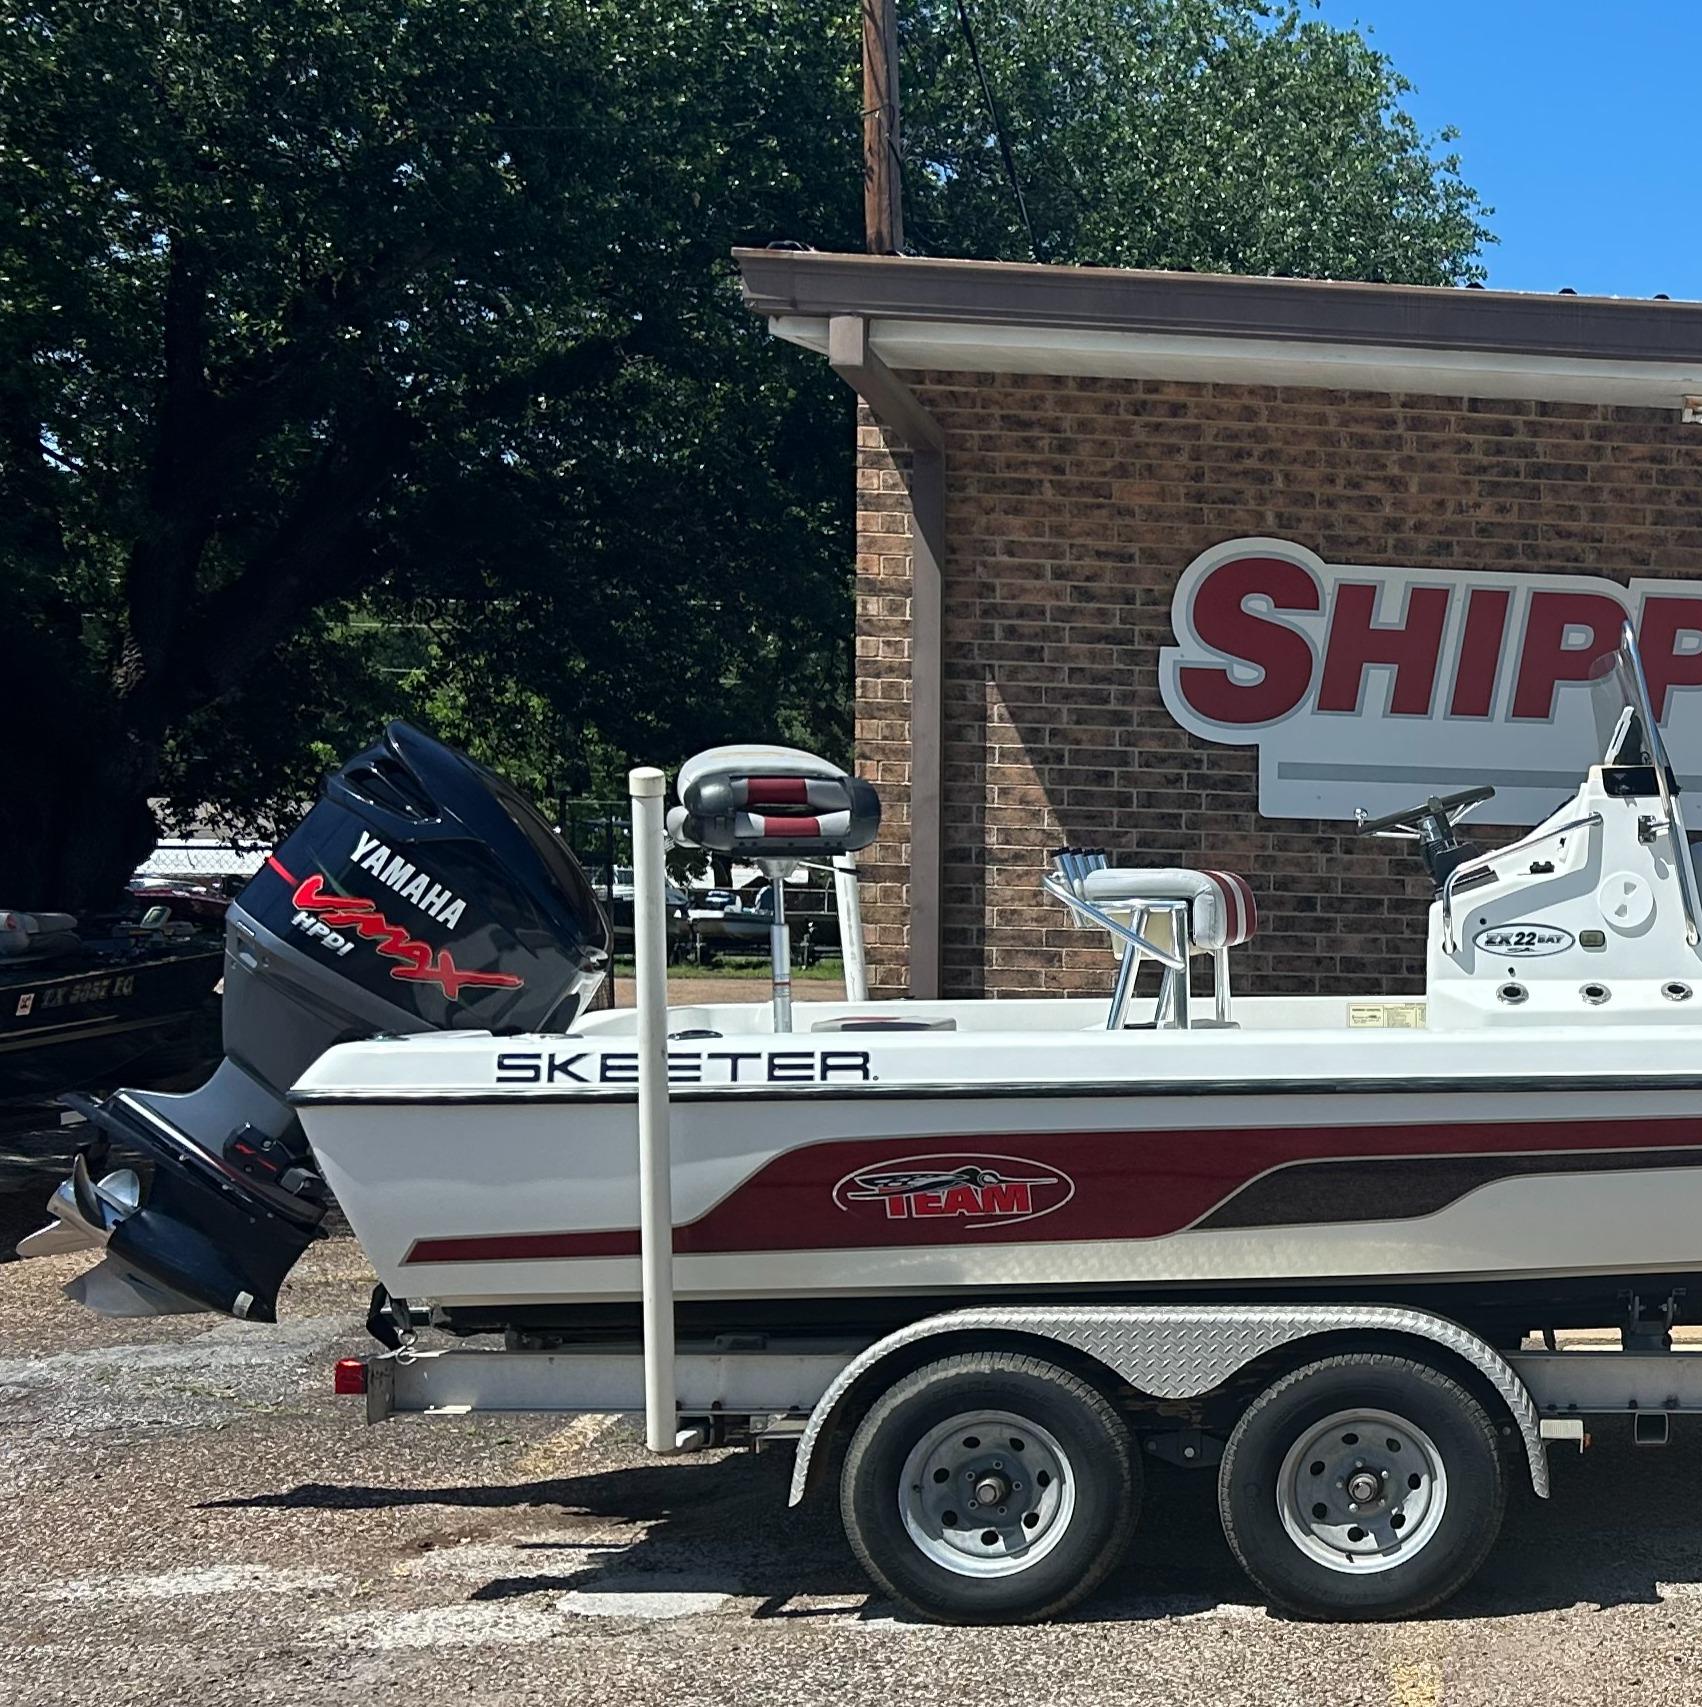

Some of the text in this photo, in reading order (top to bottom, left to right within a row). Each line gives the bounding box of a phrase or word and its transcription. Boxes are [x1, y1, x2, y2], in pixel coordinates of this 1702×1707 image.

[350, 831, 466, 930] YAMAHA
[291, 911, 354, 956] HPDI
[1514, 932, 1536, 946] 22
[496, 1052, 871, 1083] SKEETER
[886, 1183, 1033, 1219] TEAM
